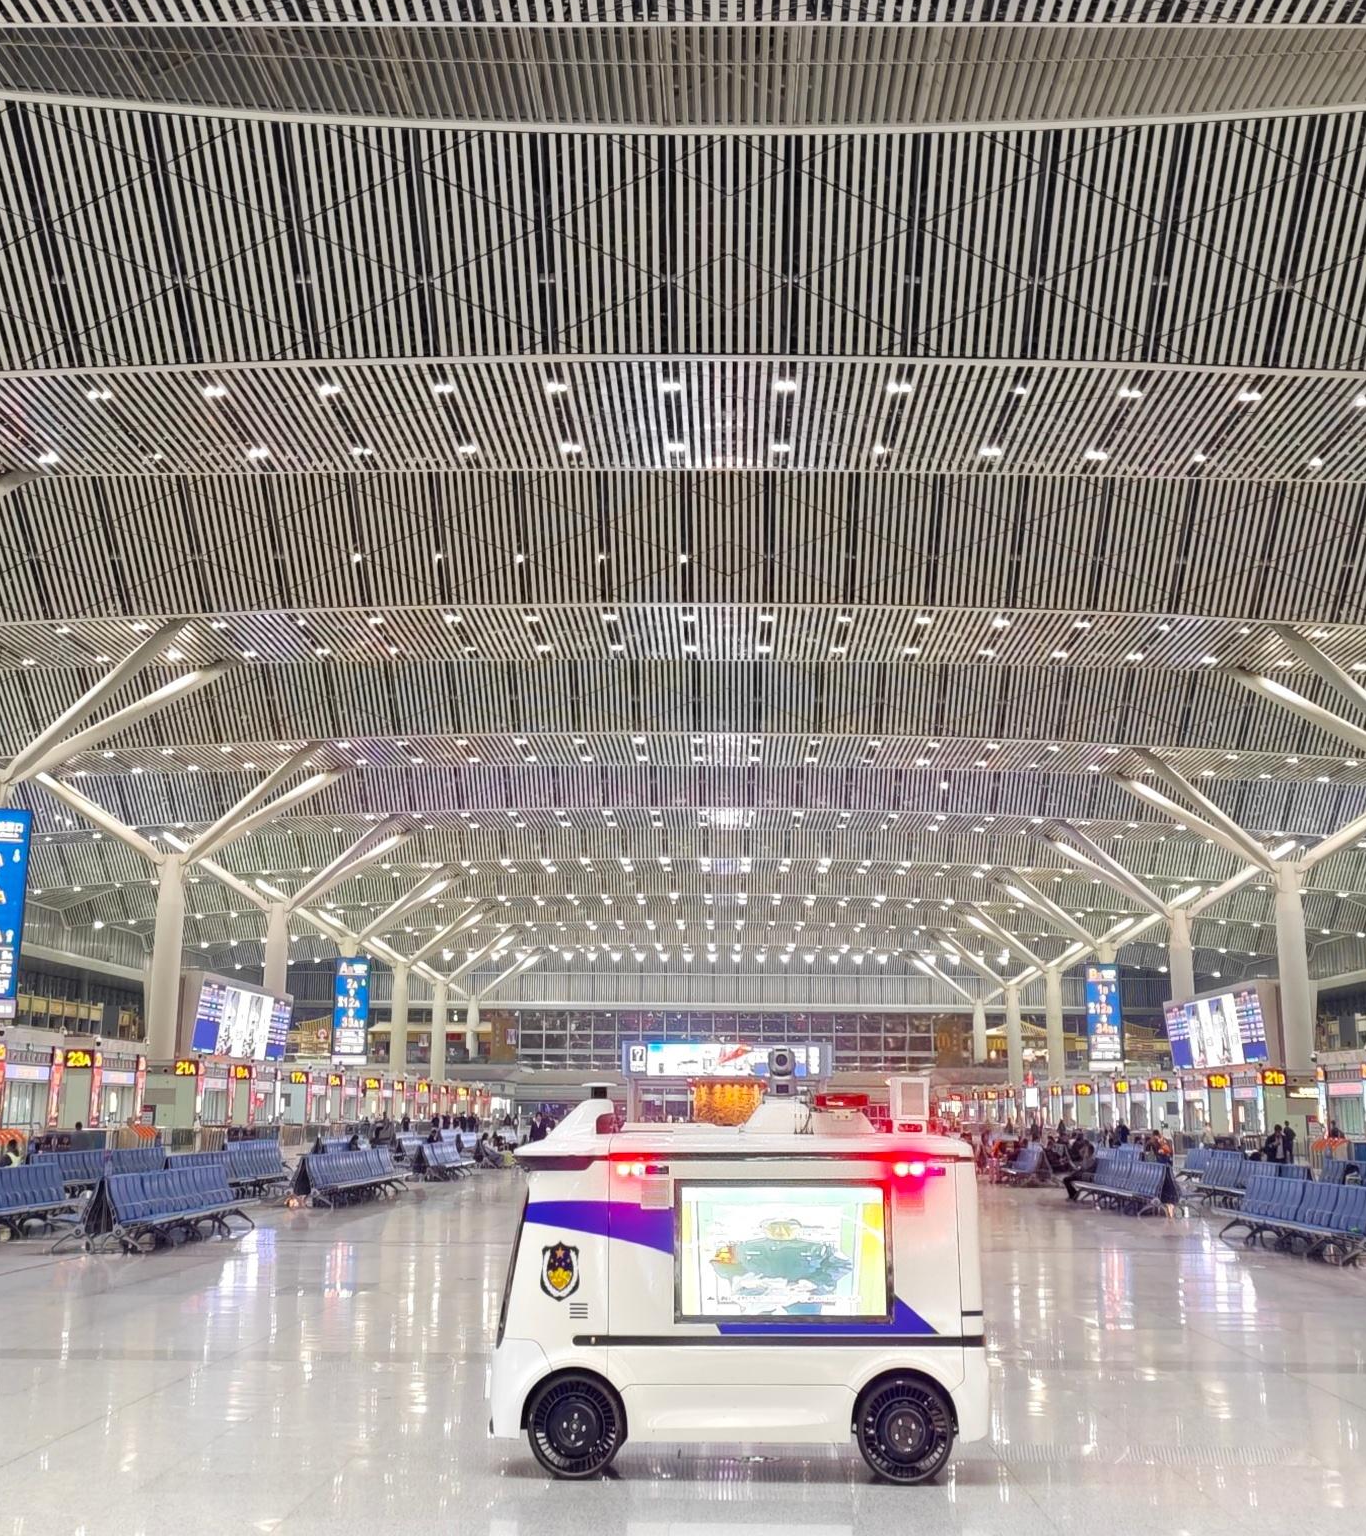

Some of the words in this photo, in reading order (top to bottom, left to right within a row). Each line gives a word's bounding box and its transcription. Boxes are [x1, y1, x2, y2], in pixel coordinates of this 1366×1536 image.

[67, 1051, 91, 1068] 23A
[176, 1061, 196, 1075] 21A
[1264, 1071, 1285, 1085] 21B
